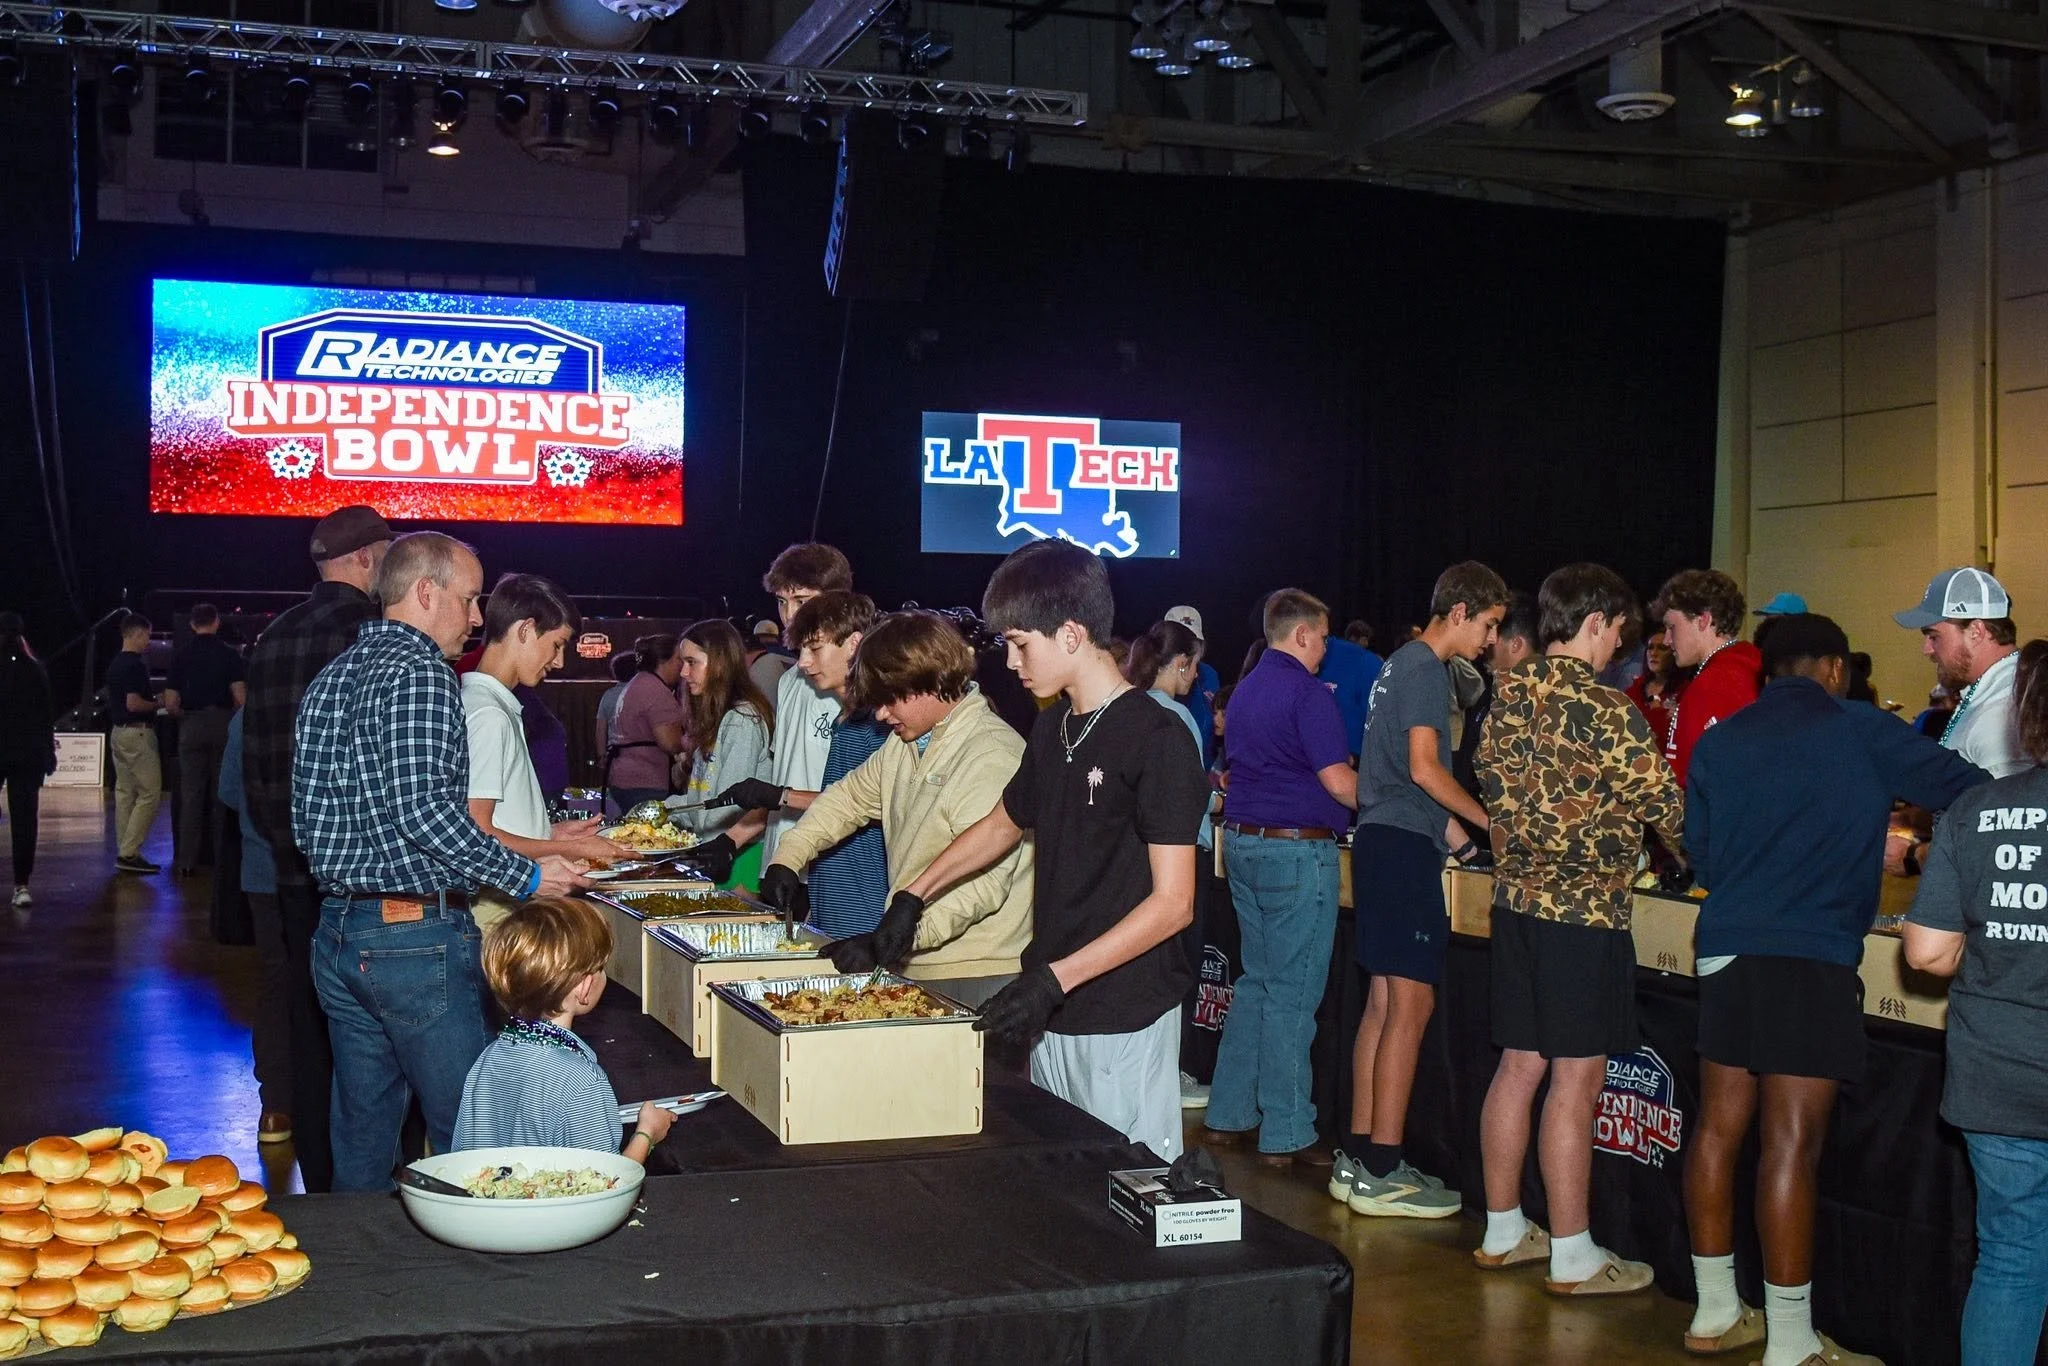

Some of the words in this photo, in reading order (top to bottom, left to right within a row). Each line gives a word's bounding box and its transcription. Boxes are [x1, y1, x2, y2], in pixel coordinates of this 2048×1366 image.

[296, 331, 567, 377] RADIANCE
[364, 363, 555, 385] TECHNOLOGIES
[229, 382, 629, 439] INDEPENDENCE
[333, 429, 530, 475] BOWL
[927, 441, 999, 482] LA
[1977, 808, 2048, 832] EMP
[1995, 844, 2041, 870] OF
[1594, 1116, 1648, 1153] OWL
[1196, 1208, 1220, 1217] powder
[1163, 1233, 1177, 1242] XL
[1180, 1233, 1203, 1241] 60154
